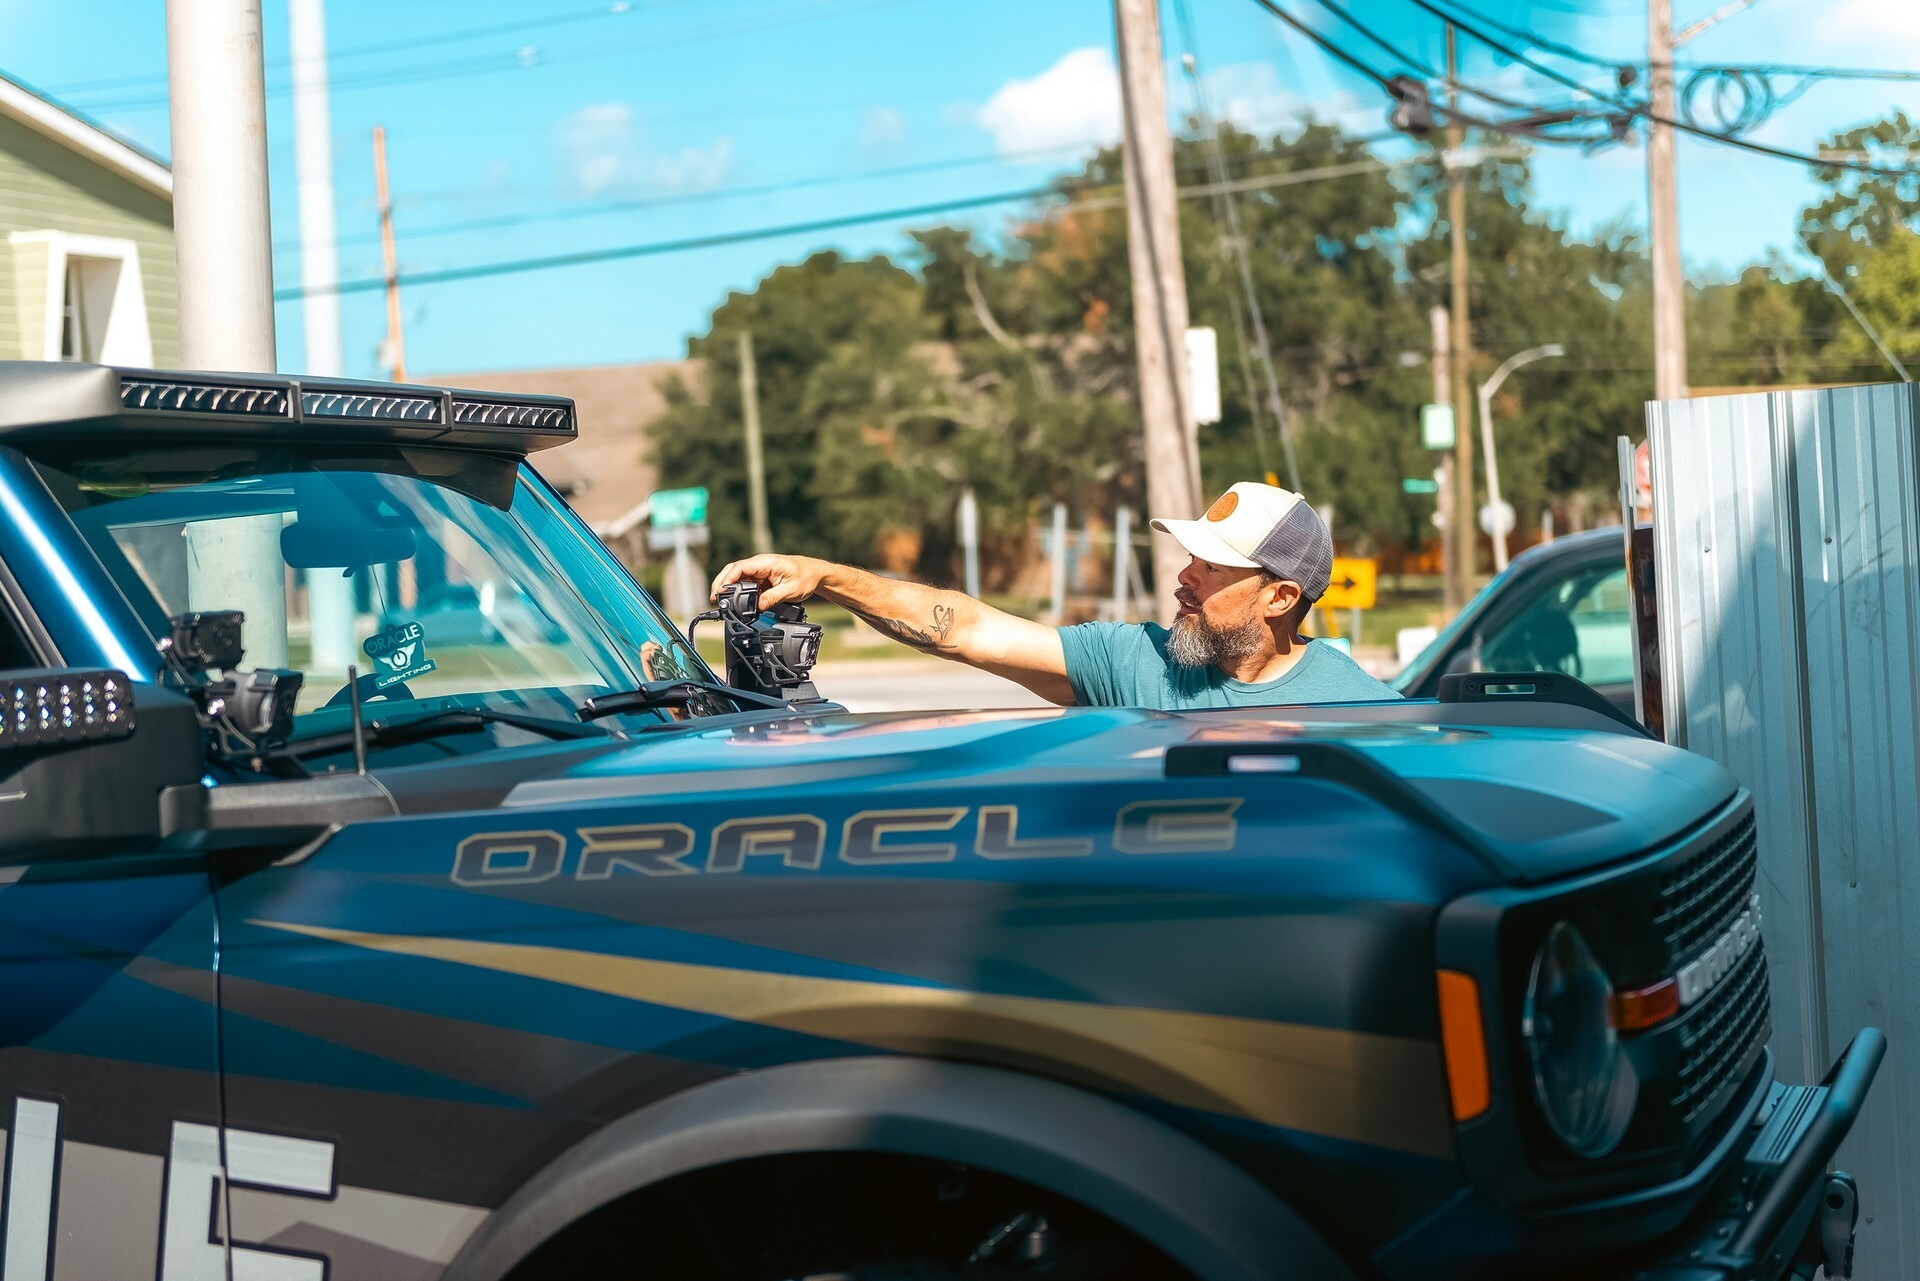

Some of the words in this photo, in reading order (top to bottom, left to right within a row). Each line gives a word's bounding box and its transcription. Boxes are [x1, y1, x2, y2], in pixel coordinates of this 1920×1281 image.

[366, 624, 421, 654] ORACLE
[378, 663, 432, 687] LIGHTING
[450, 797, 1246, 887] ORACLE
